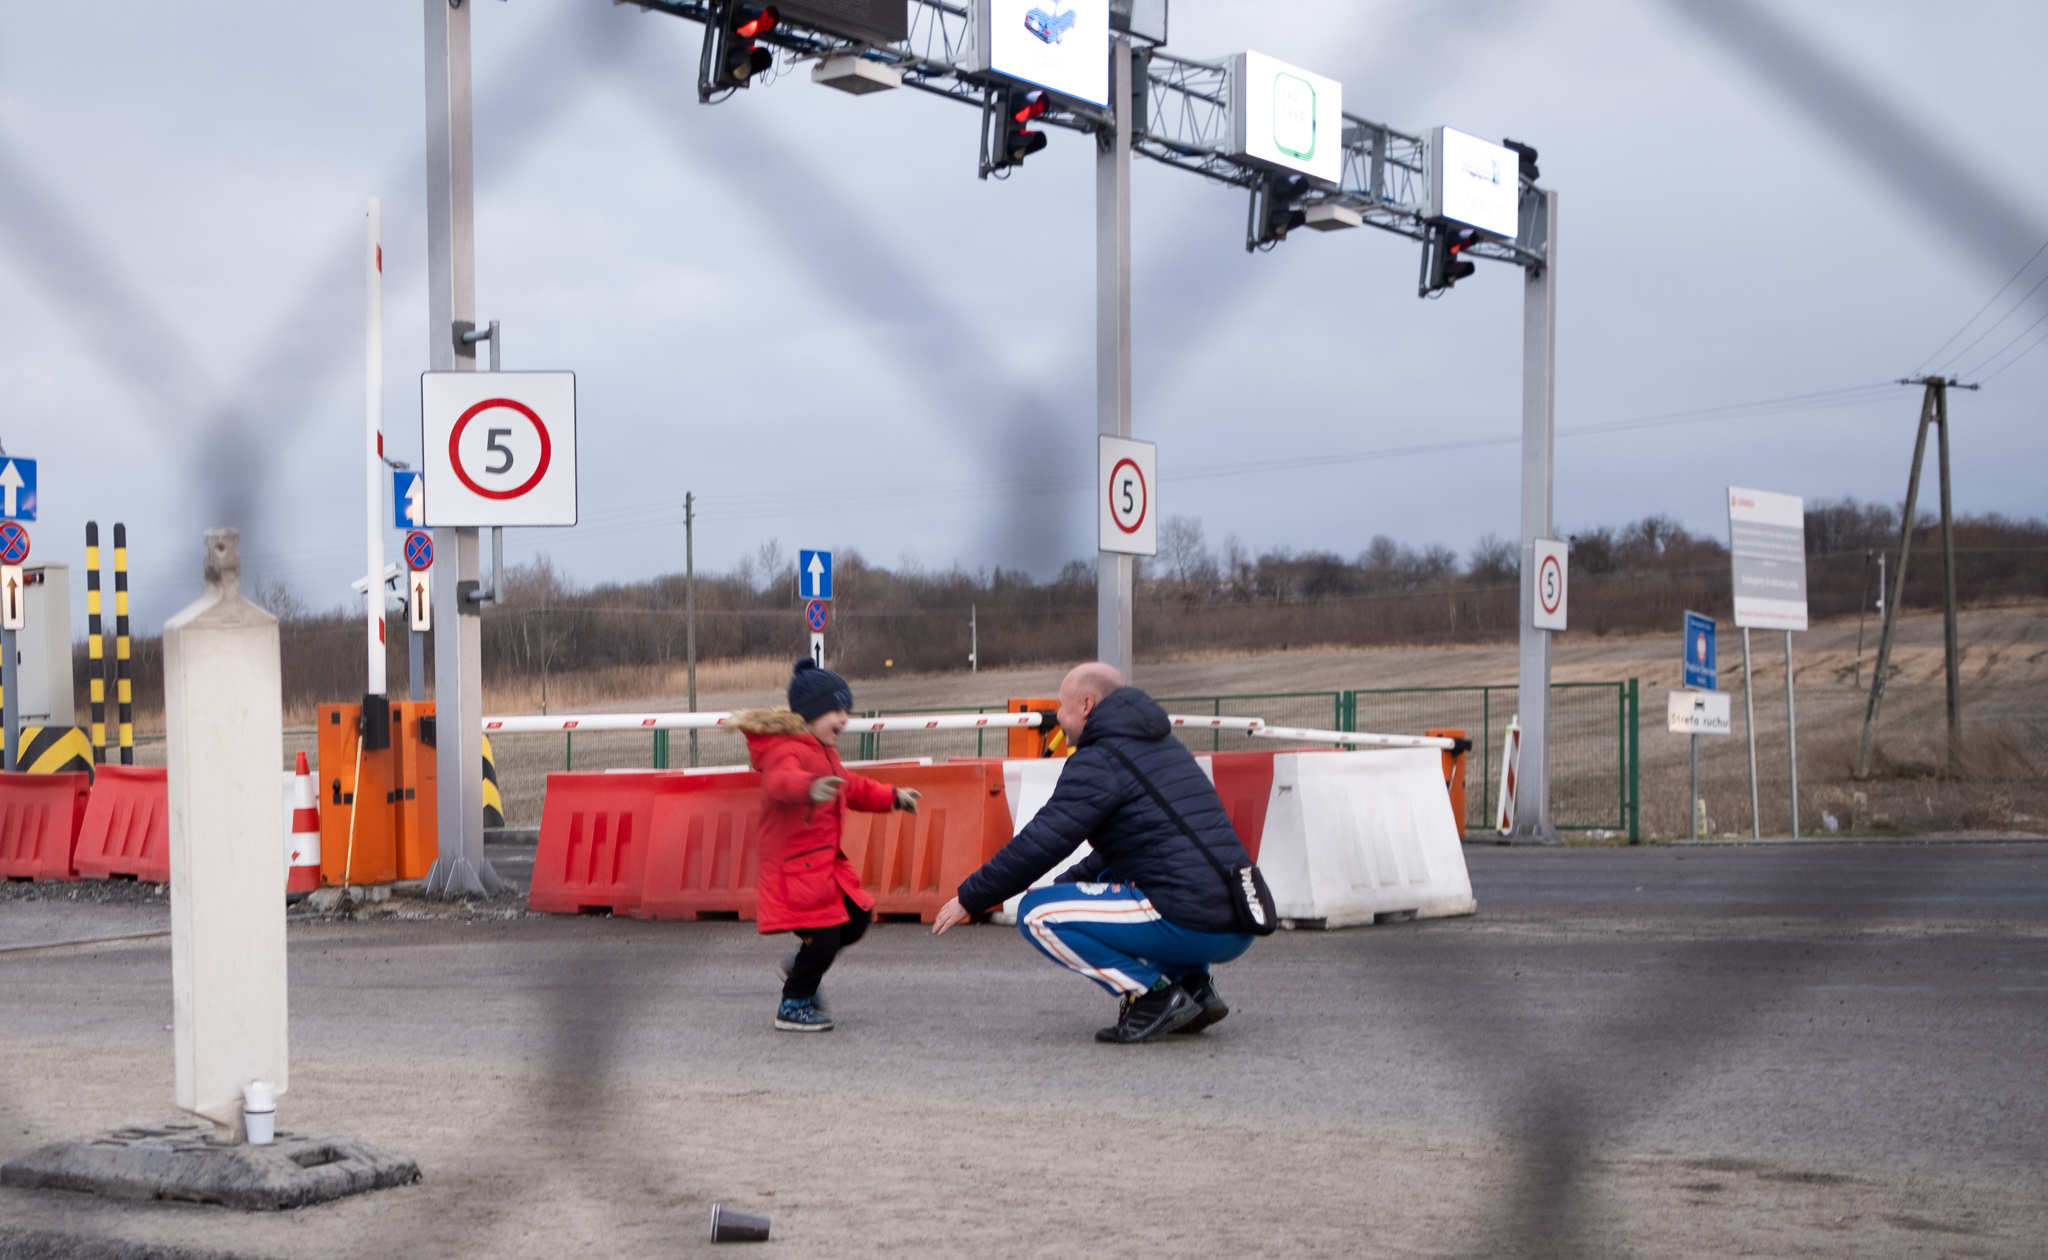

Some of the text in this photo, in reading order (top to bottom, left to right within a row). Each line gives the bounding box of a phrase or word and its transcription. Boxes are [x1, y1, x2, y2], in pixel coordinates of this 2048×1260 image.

[1032, 49, 1068, 76] CARS
[1281, 86, 1300, 104] TAX
[1281, 105, 1306, 126] FREE
[485, 428, 514, 474] 5
[1122, 479, 1134, 515] 5
[1547, 572, 1554, 599] 5
[1671, 713, 1728, 728] Strefa ruchu
